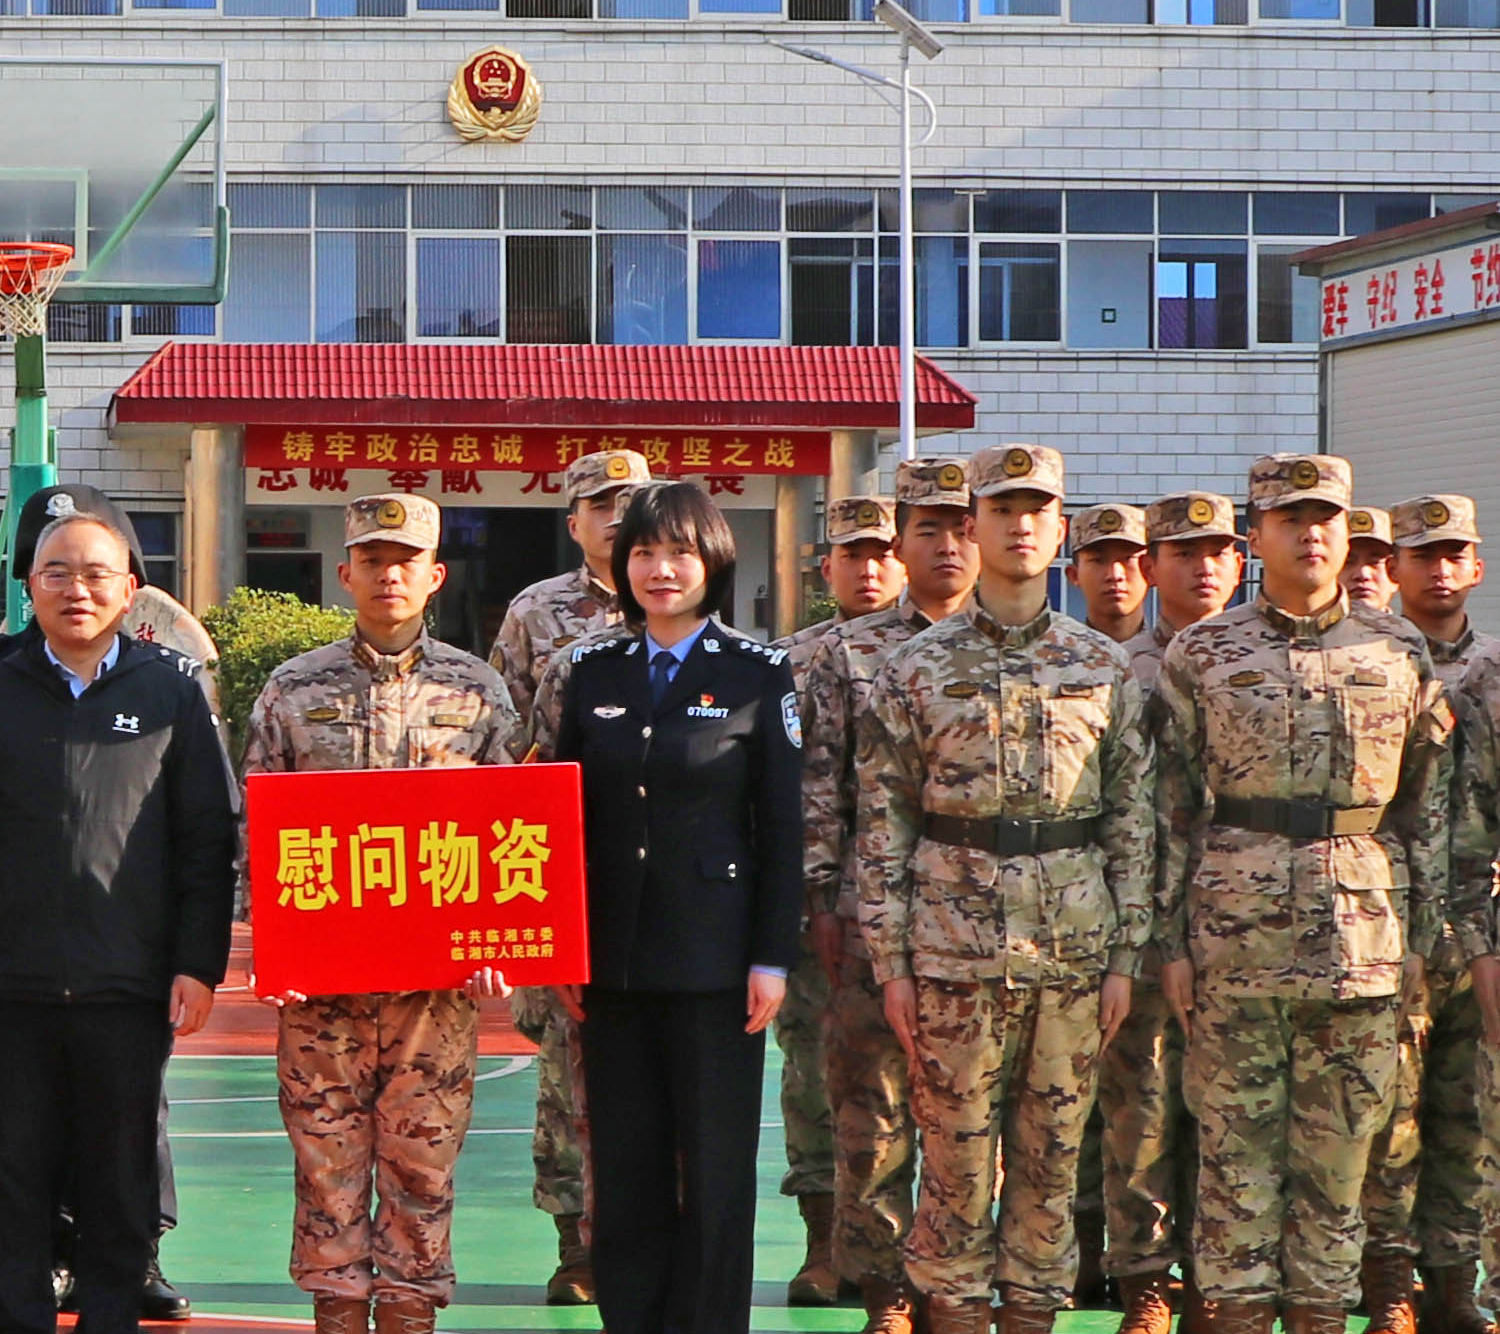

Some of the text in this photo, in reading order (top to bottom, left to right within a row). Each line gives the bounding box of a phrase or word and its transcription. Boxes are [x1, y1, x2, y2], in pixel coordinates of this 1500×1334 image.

[1322, 280, 1349, 337] 爱车
[1366, 269, 1398, 330] 守纪
[1413, 259, 1445, 320] 安全
[282, 431, 525, 465] 铸牢政治忠诚
[275, 817, 552, 911] 慰问物资
[450, 927, 554, 944] 中共临湘市委
[450, 943, 555, 962] 临湘市人民政府
